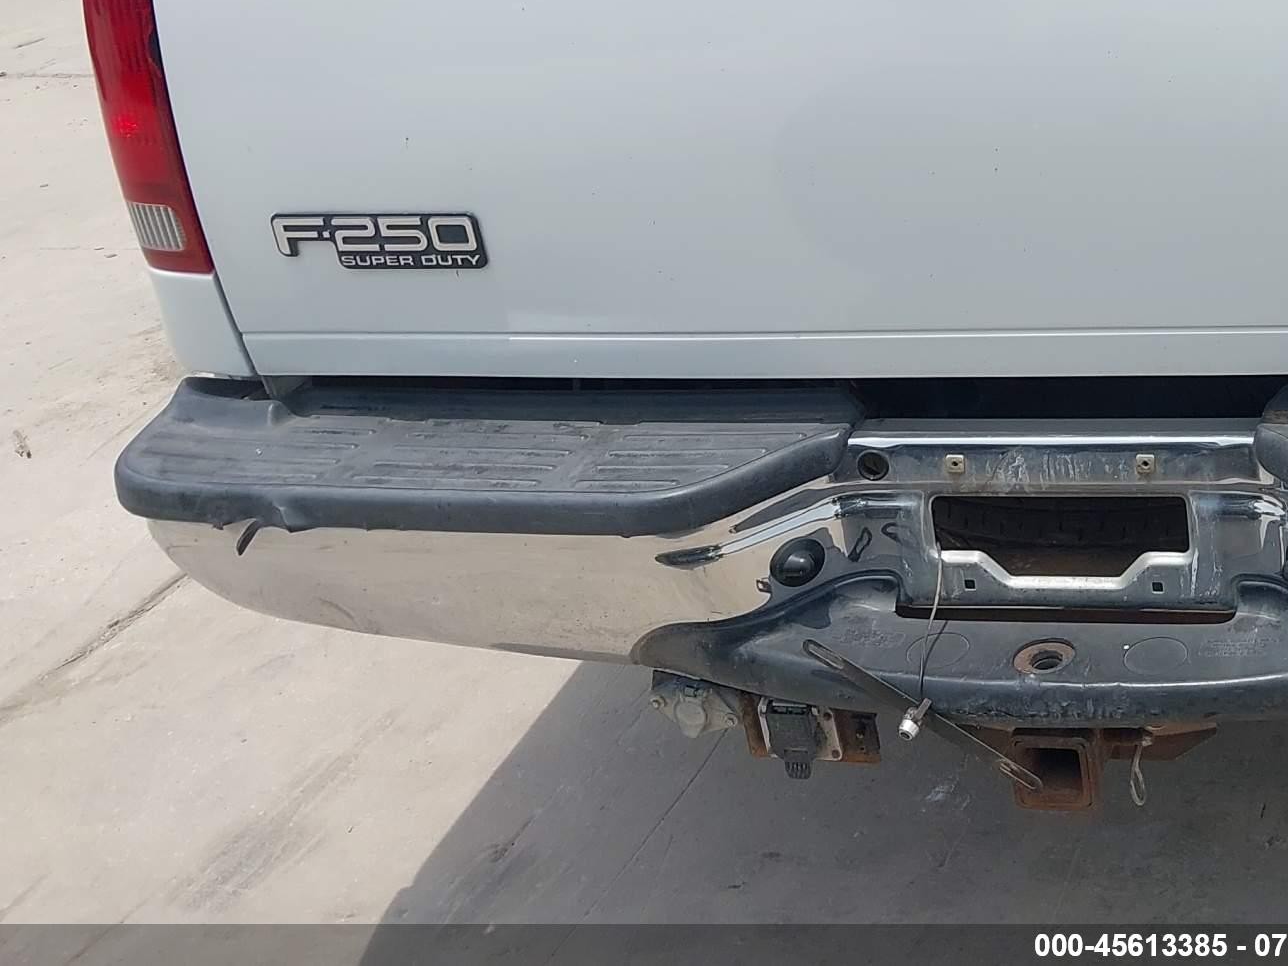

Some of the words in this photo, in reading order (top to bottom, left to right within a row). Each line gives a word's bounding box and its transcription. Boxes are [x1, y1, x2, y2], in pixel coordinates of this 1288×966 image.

[271, 216, 478, 256] F-250
[341, 254, 415, 267] SUPER
[421, 253, 481, 266] DUTY
